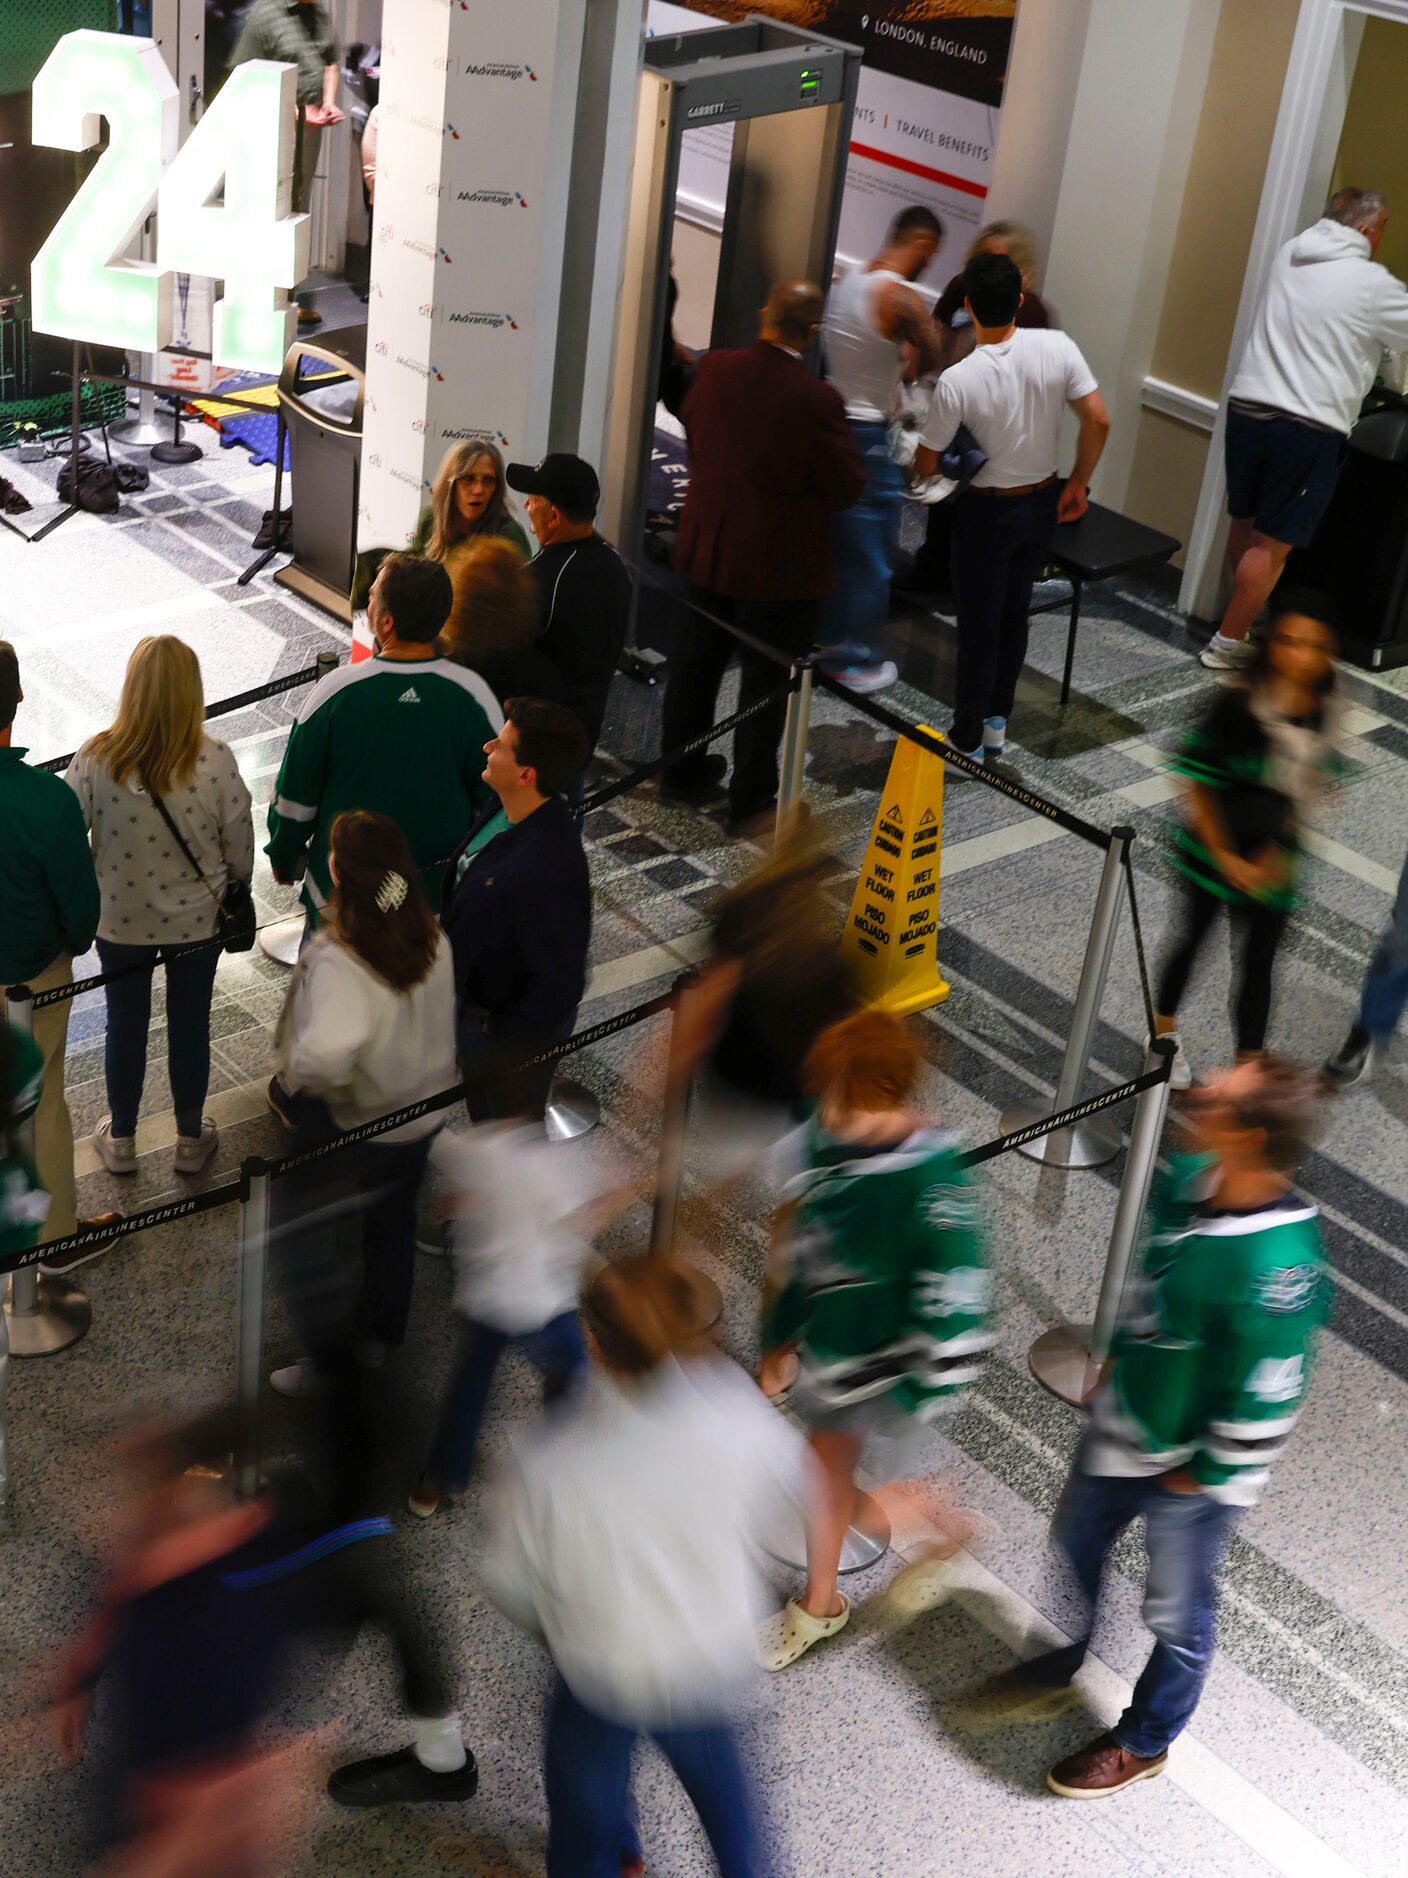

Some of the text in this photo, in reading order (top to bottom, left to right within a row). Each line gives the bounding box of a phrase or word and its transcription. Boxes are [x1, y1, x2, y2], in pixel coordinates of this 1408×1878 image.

[874, 18, 988, 65] LONDON, ENGLAND
[466, 65, 523, 80] AAdvantage
[687, 102, 726, 119] GARRETT
[896, 119, 936, 145] TRAVEL
[938, 133, 990, 162] BENEFITS
[30, 29, 311, 376] 24
[457, 191, 514, 207] AAdvantage
[448, 313, 505, 328] AAdvantage
[879, 819, 905, 842] CAUTION
[913, 825, 939, 843] CAUTION
[875, 864, 895, 884] WET
[913, 868, 933, 885] WET
[865, 877, 895, 903] FLOOR
[907, 883, 936, 903] FLOOR
[864, 904, 885, 925] PISO
[909, 909, 929, 926] PISO
[853, 915, 890, 945] MOJADO
[899, 922, 936, 945] MOJADO
